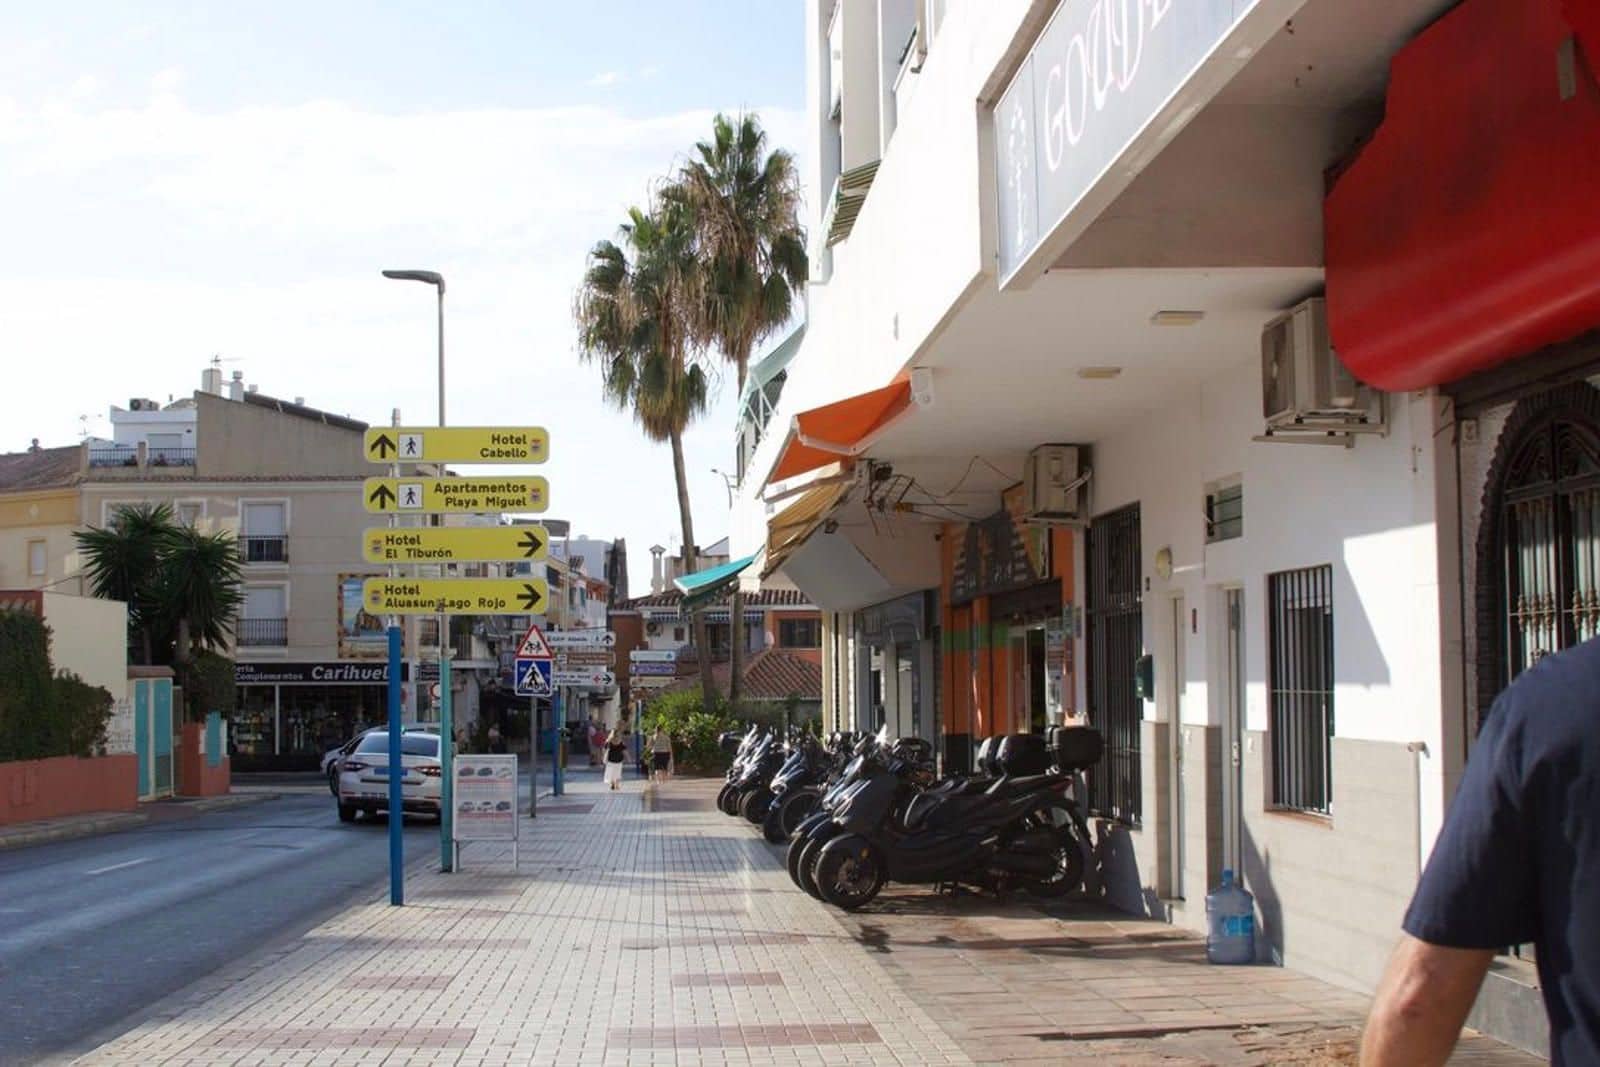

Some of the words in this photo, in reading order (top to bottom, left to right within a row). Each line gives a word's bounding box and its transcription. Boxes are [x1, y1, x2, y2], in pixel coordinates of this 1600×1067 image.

[491, 434, 527, 445] Hotel
[480, 447, 528, 458] Cabello
[434, 483, 527, 495] Apartamentos
[445, 497, 478, 508] Playa
[485, 497, 527, 508] Miguel
[385, 535, 421, 545] Hotel
[385, 549, 398, 559] El
[406, 548, 453, 559] Tiburón
[385, 585, 421, 595] Hotel
[443, 598, 471, 609] Lago
[478, 598, 506, 610] Rojo
[311, 665, 390, 680] Carihuel
